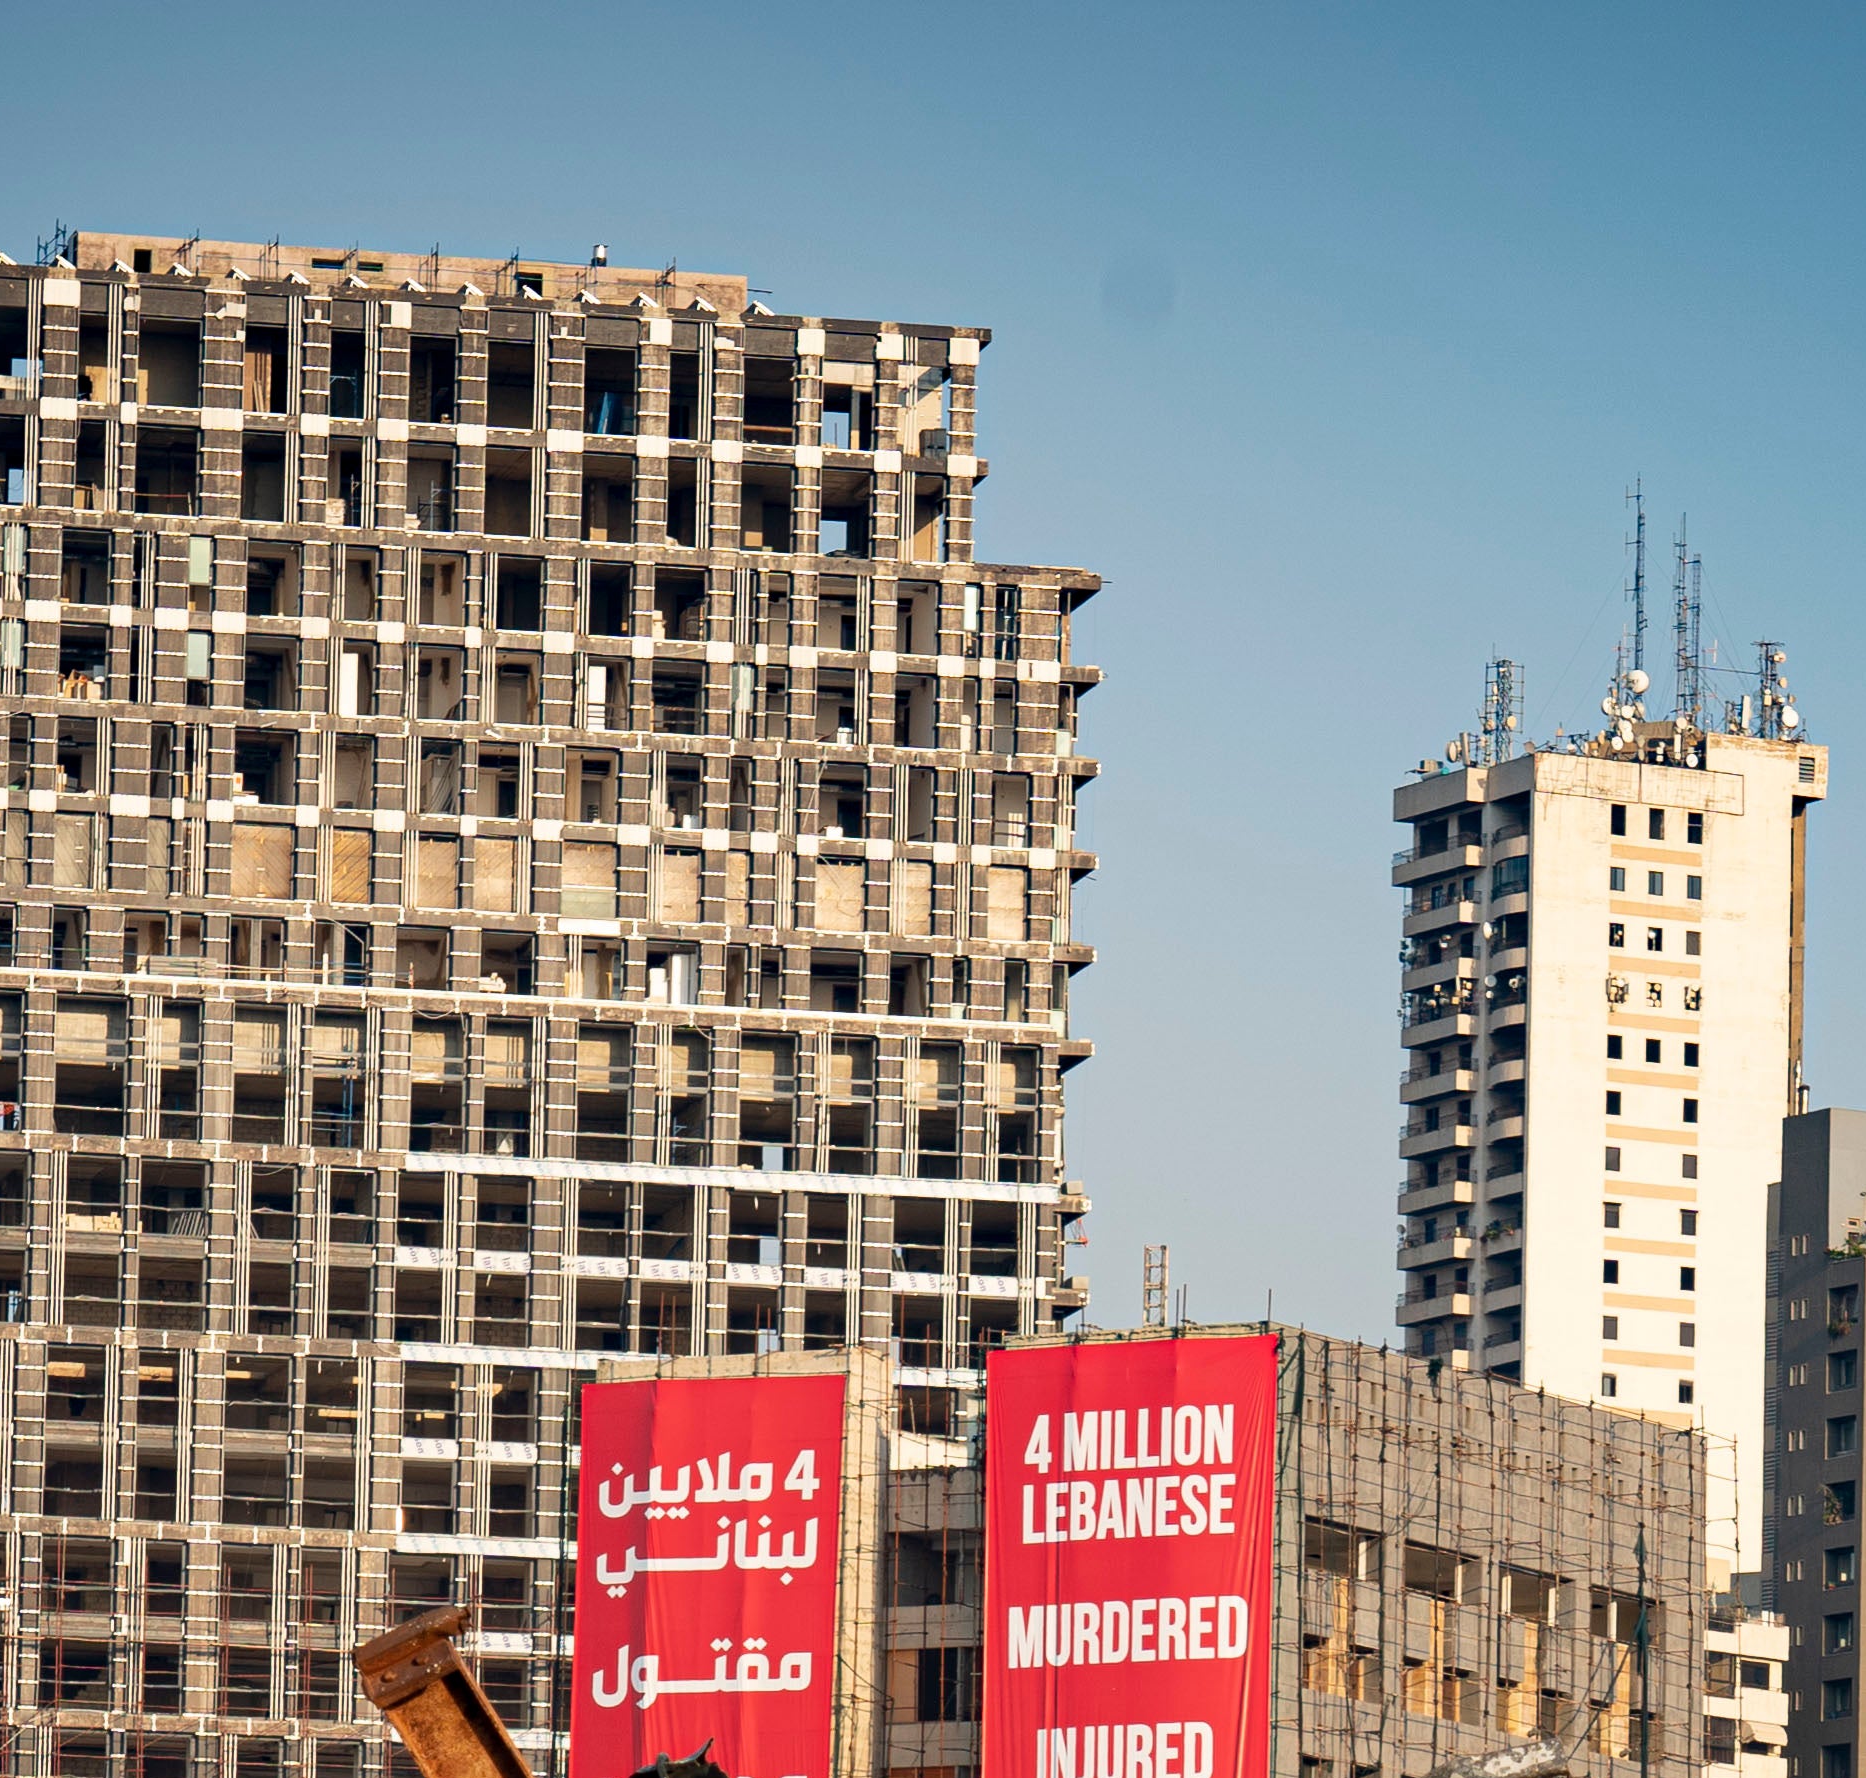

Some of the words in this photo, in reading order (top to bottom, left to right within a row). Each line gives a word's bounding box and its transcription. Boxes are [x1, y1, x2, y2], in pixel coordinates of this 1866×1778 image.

[1024, 1414, 1052, 1474] 4
[1063, 1403, 1235, 1472] MILLION
[598, 1451, 774, 1521] ملايين
[783, 1449, 820, 1500] 4
[1022, 1473, 1237, 1545] LEBANESE
[1007, 1595, 1249, 1670] MURDERED
